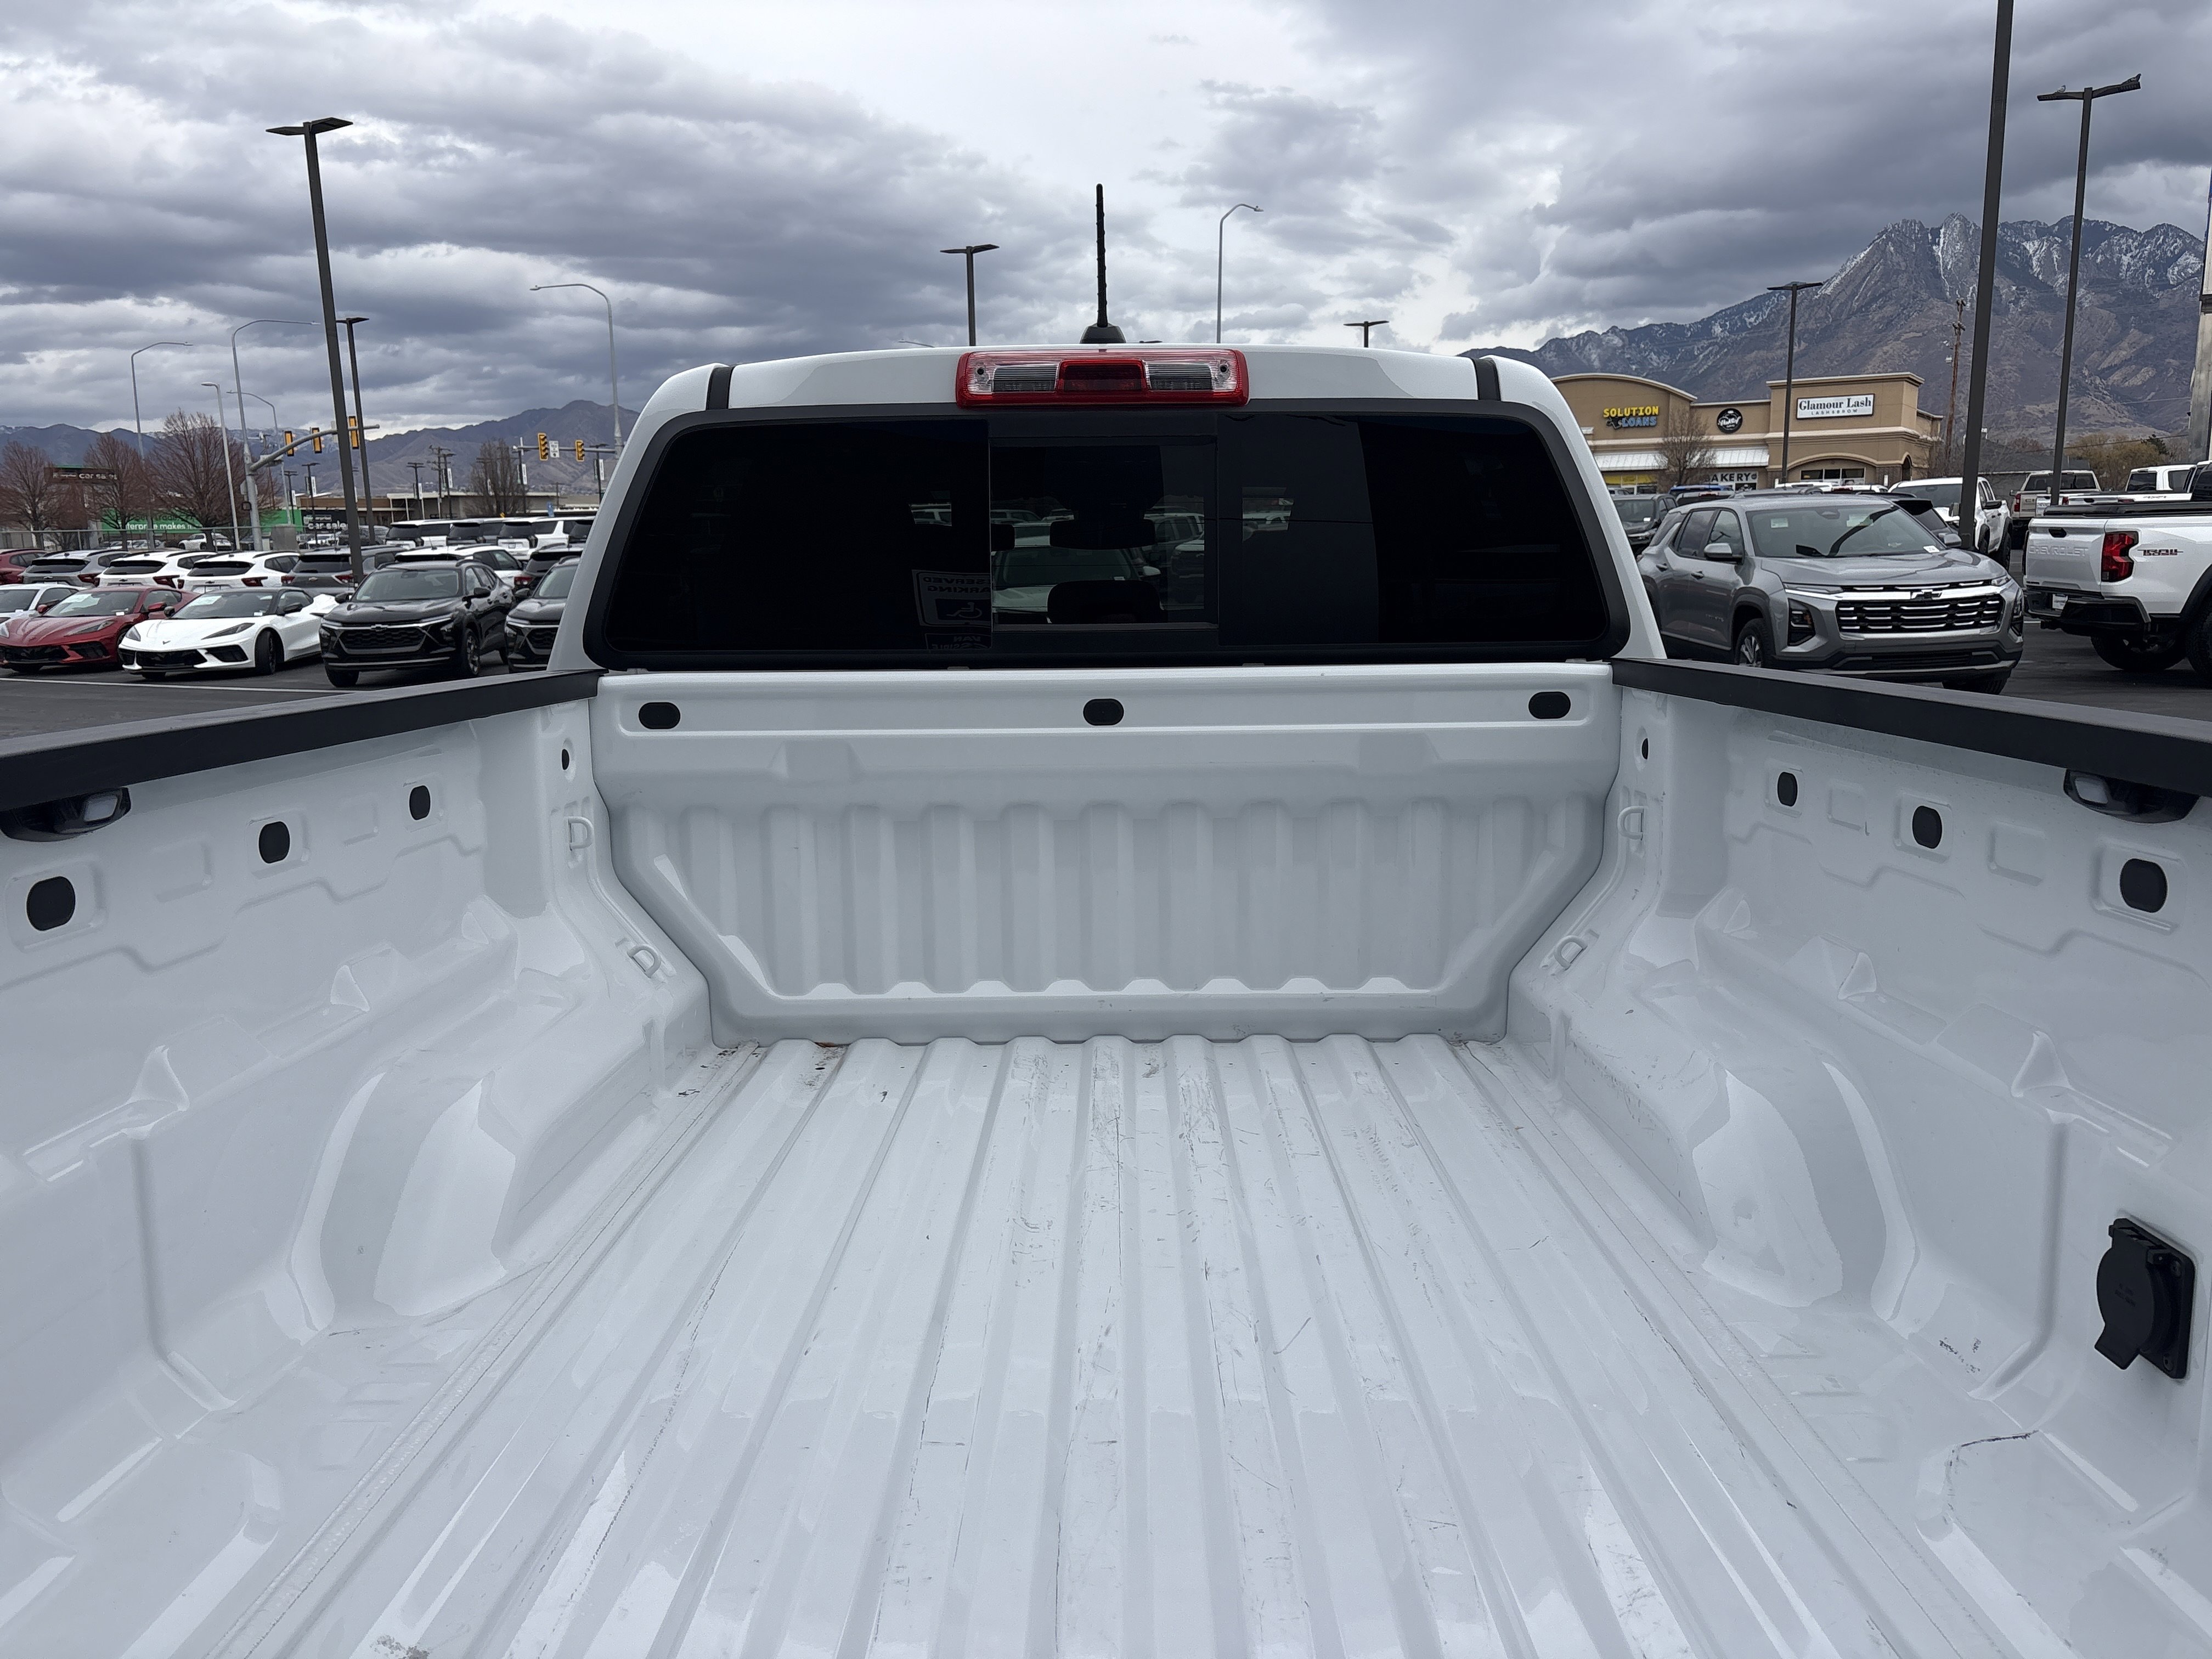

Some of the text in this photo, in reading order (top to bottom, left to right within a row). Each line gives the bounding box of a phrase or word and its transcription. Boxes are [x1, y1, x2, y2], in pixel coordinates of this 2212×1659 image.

[1799, 397, 1871, 411] Glamour Lash
[1603, 405, 1659, 418] SOLUTION
[1622, 416, 1657, 427] LOANS
[160, 522, 185, 530] makes
[326, 520, 348, 530] sale
[2028, 544, 2089, 556] CHEVROLET
